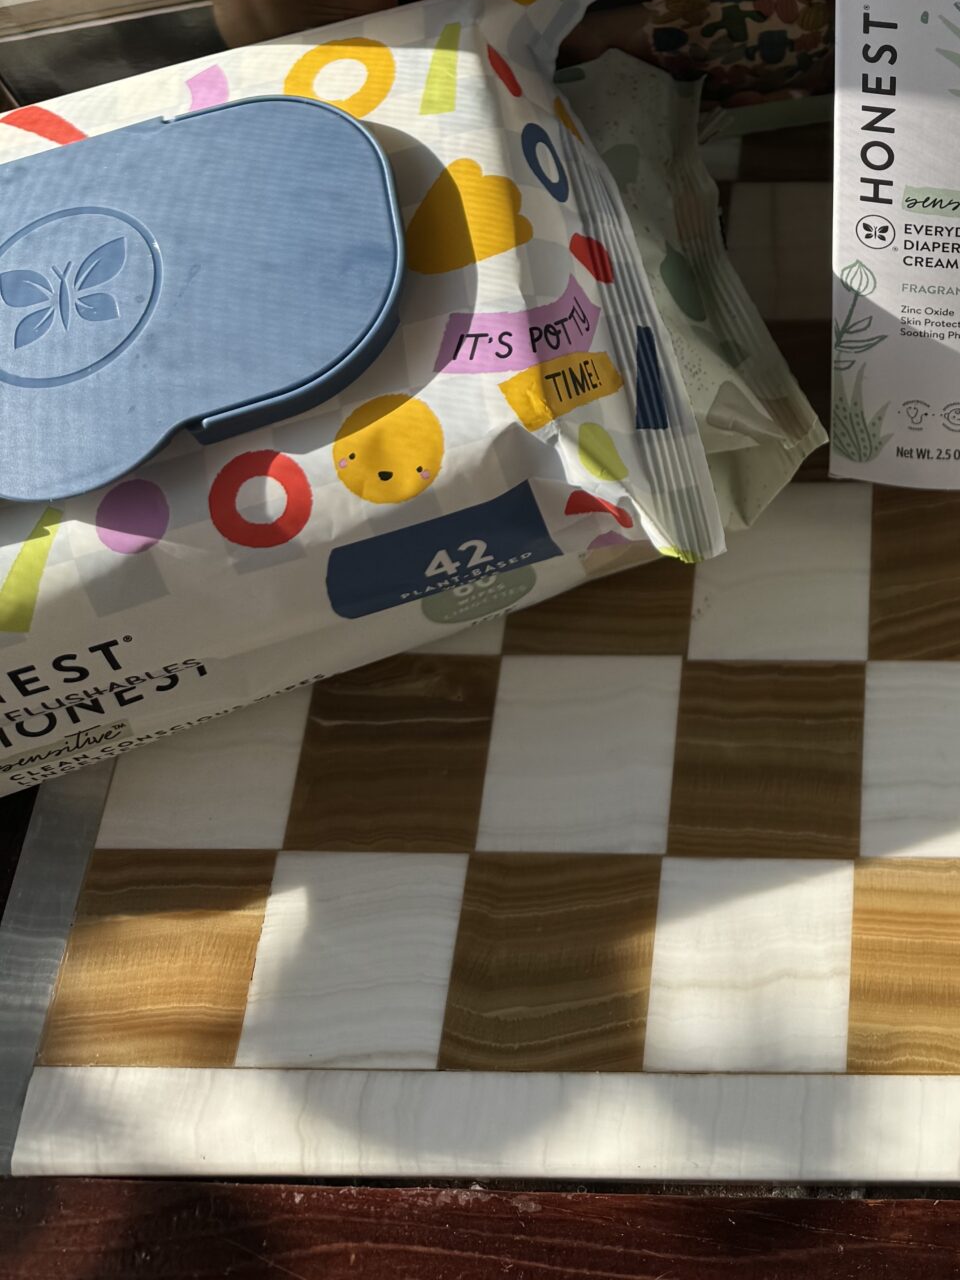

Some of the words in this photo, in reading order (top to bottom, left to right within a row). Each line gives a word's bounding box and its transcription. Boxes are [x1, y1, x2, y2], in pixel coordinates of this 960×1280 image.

[903, 240, 960, 254] DIAPER
[903, 255, 959, 269] CREAM
[900, 305, 922, 315] Zinc
[924, 306, 955, 317] Oxide
[900, 316, 921, 326] Skin
[452, 332, 513, 361] IT'S
[529, 297, 591, 353] POTTY
[900, 328, 945, 340] Soothing
[545, 359, 603, 403] TIME!
[896, 446, 914, 458] Net
[916, 448, 933, 459] Wt.
[935, 448, 951, 460] 2.5
[424, 539, 494, 577] 42
[400, 552, 532, 599] PLANT-BASED
[4, 658, 202, 721] FLUSHABLES
[10, 754, 90, 782] CLEAN
